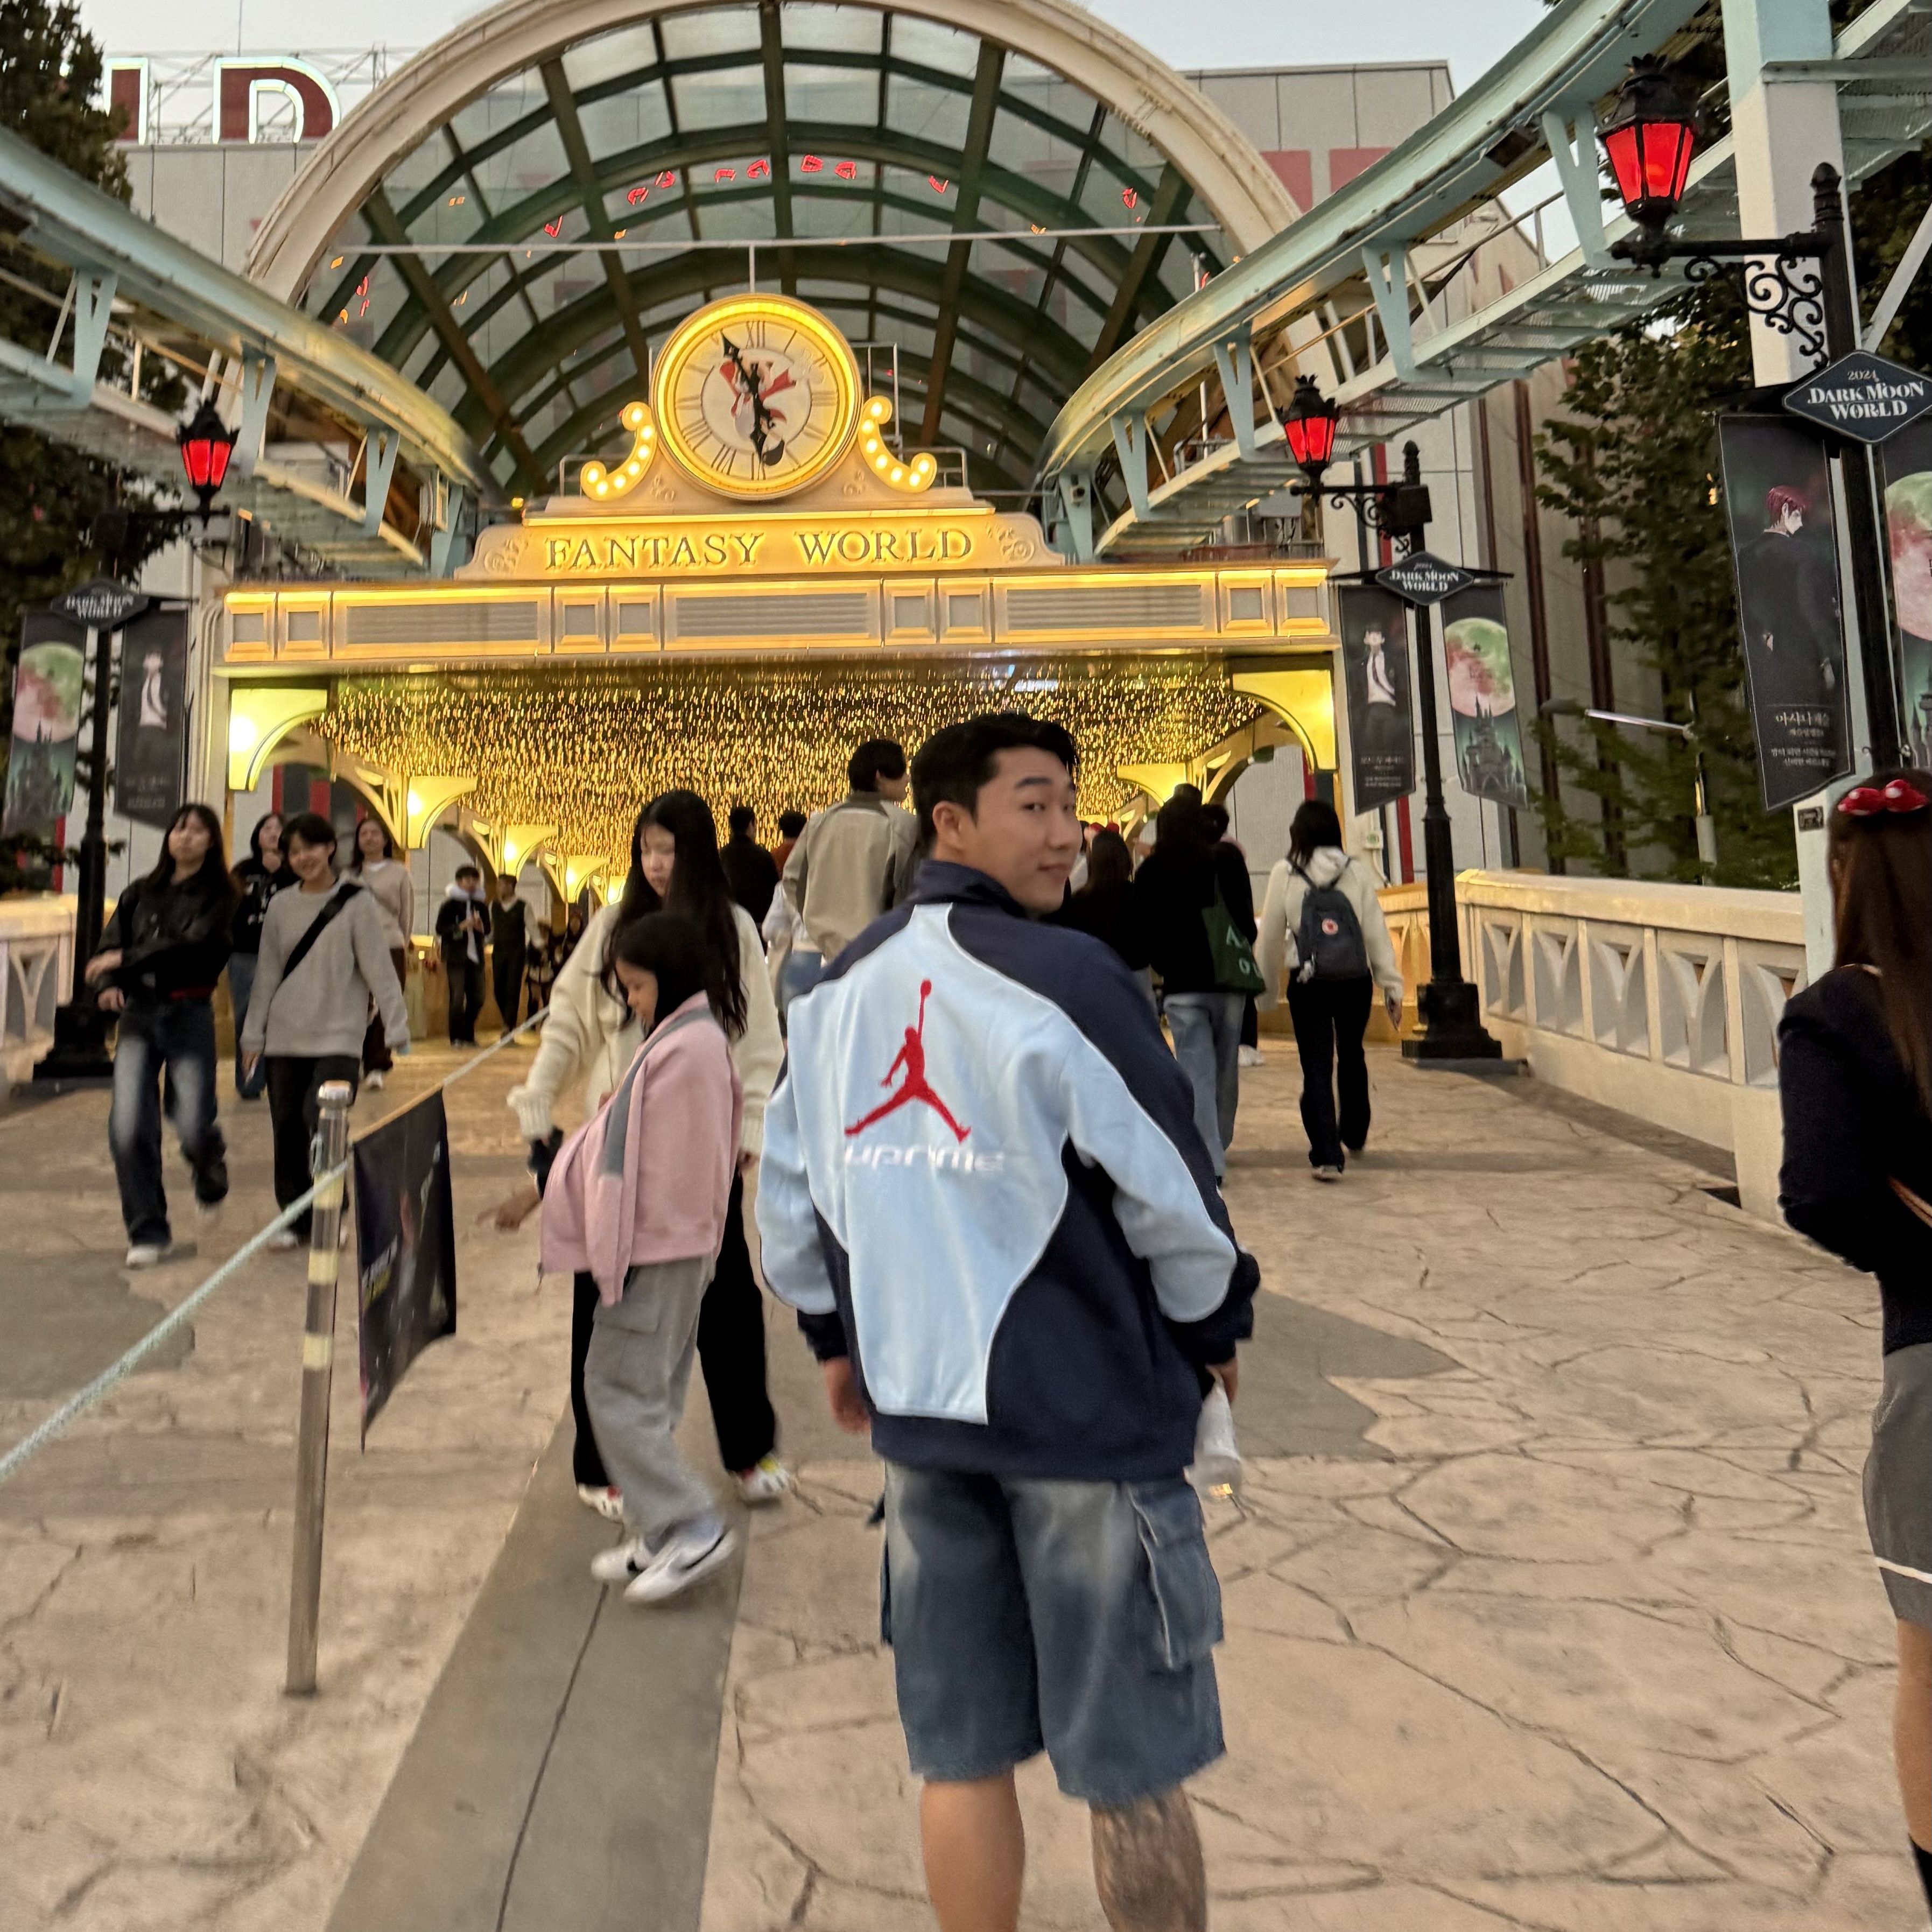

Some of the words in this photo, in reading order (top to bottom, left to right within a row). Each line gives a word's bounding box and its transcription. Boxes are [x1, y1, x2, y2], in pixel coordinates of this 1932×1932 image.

[1847, 369, 1880, 382] 2024
[1807, 387, 1864, 404] DARK
[1866, 381, 1924, 400] MOON
[1829, 400, 1908, 420] WORLD
[544, 532, 764, 572] FANTASY
[793, 528, 973, 565] WORLD
[1402, 580, 1449, 592] WORLD
